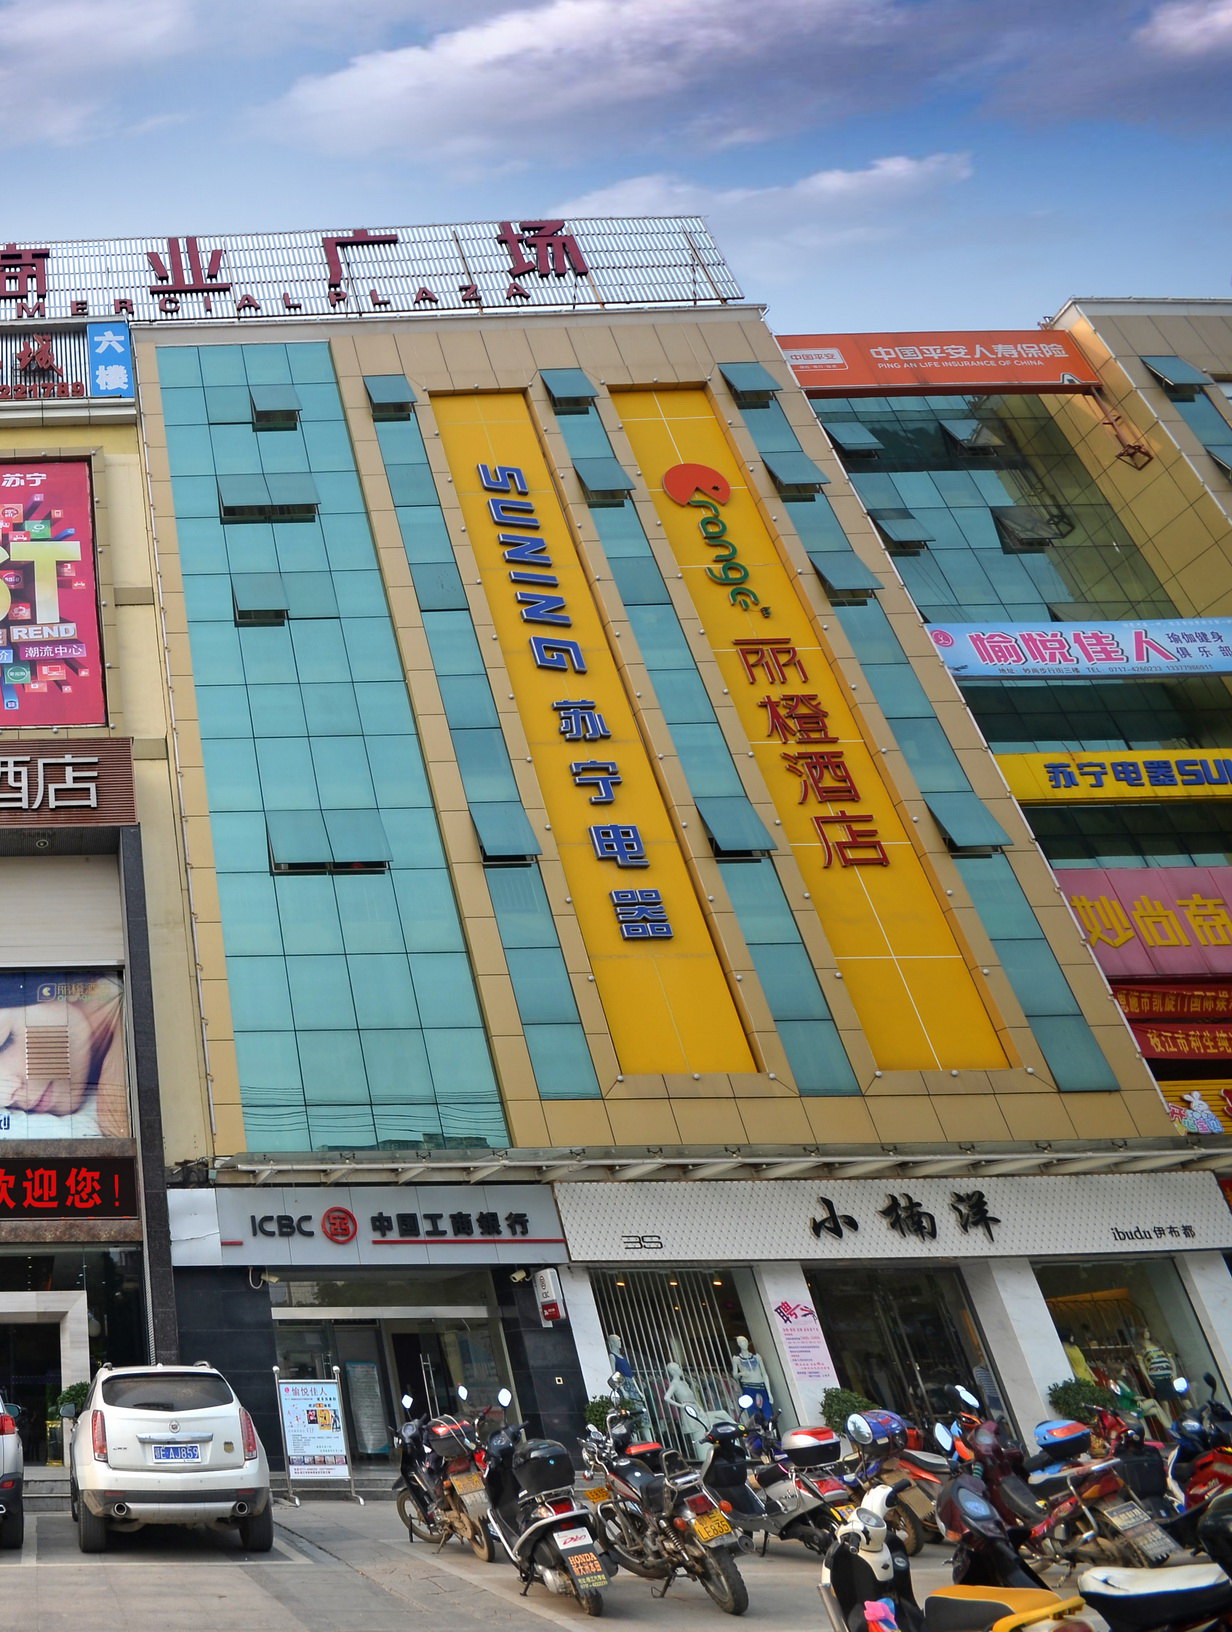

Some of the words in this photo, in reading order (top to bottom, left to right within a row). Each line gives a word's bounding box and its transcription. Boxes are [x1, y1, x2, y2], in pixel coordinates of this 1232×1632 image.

[93, 329, 129, 391] 六楼
[870, 343, 1070, 361] 中国平安人寿保险
[1, 472, 47, 488] 苏宁
[12, 625, 77, 641] REND
[1165, 630, 1224, 644] 瑜伽健身
[24, 645, 84, 658] 潮流中心
[968, 628, 1180, 666] 愉悦佳人
[1176, 645, 1232, 659] 俱乐部
[476, 462, 589, 675] SUNING
[551, 698, 674, 941] 苏宁电器
[732, 637, 890, 869] 丽橙酒店
[250, 1214, 315, 1238] ICBC
[370, 1211, 530, 1237] 中国工商银行
[567, 1551, 598, 1566] HONDA
